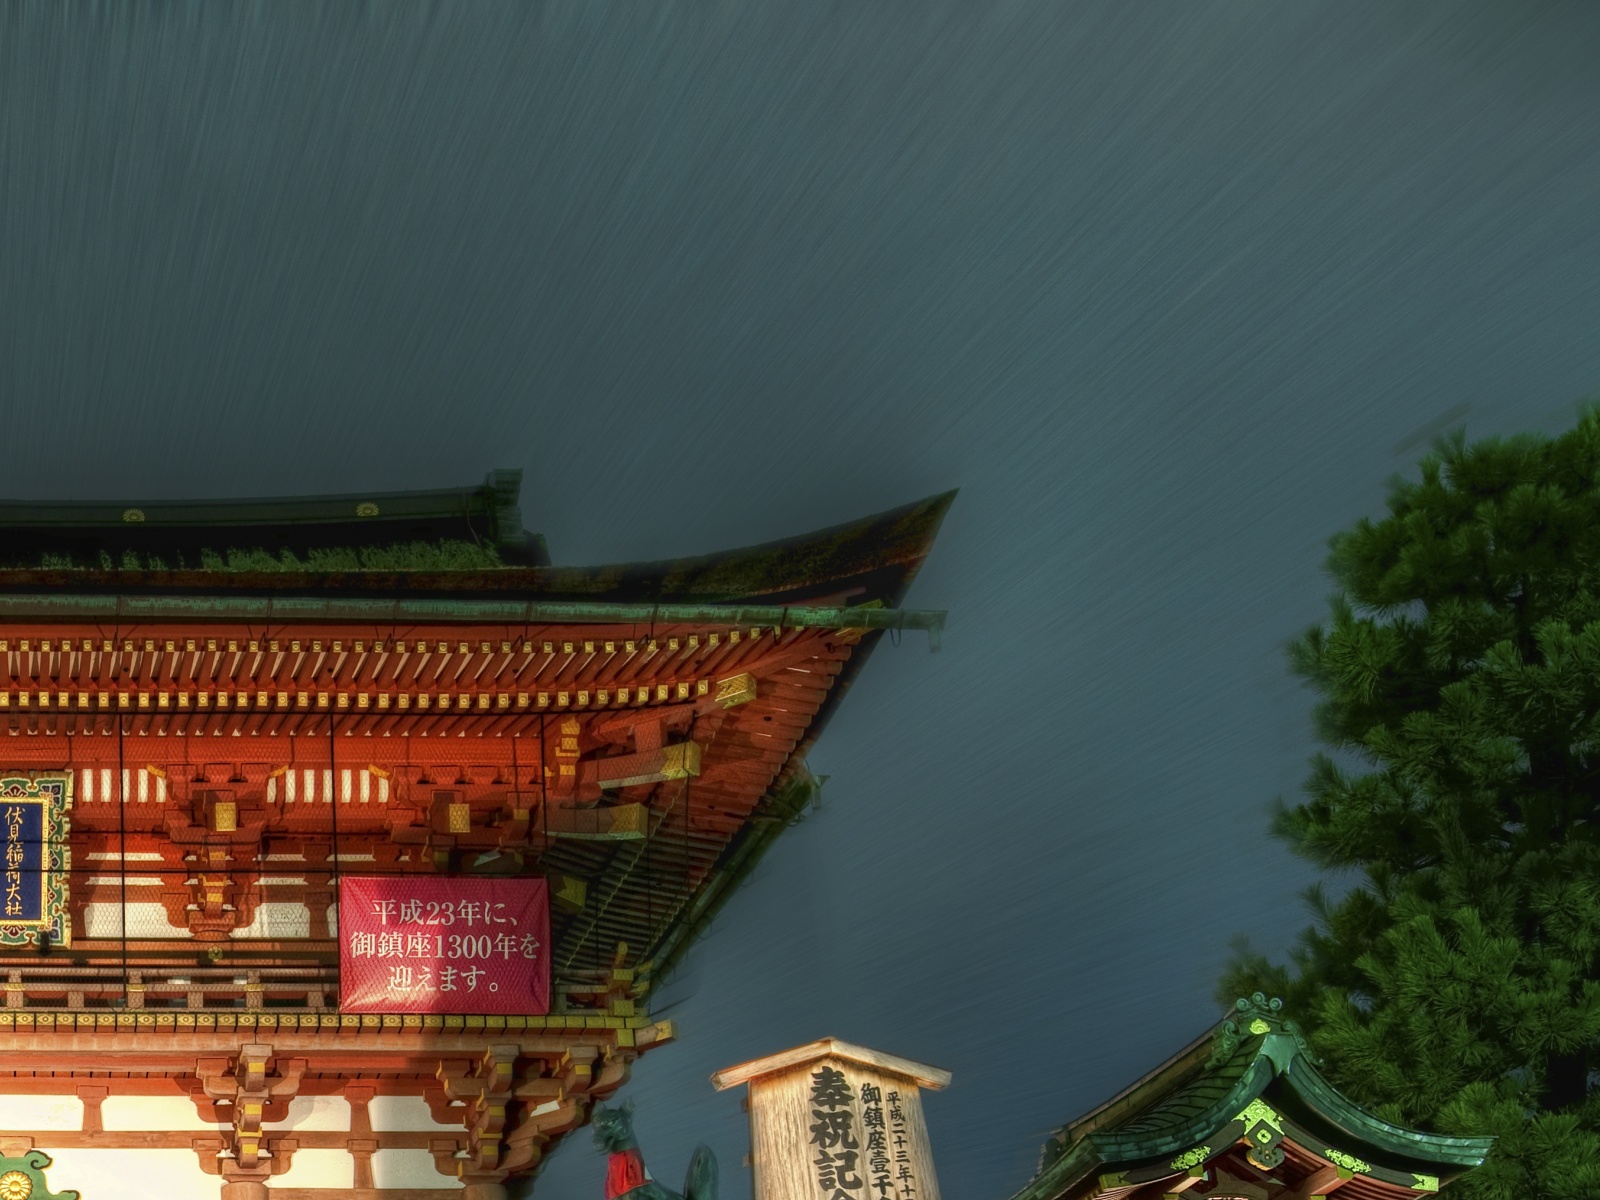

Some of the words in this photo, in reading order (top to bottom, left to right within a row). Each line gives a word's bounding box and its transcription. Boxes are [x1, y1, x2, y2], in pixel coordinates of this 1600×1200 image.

[370, 898, 518, 926] 平成23年に、
[350, 931, 541, 960] 御鎮座1300年を
[386, 965, 499, 993] 迎えます。
